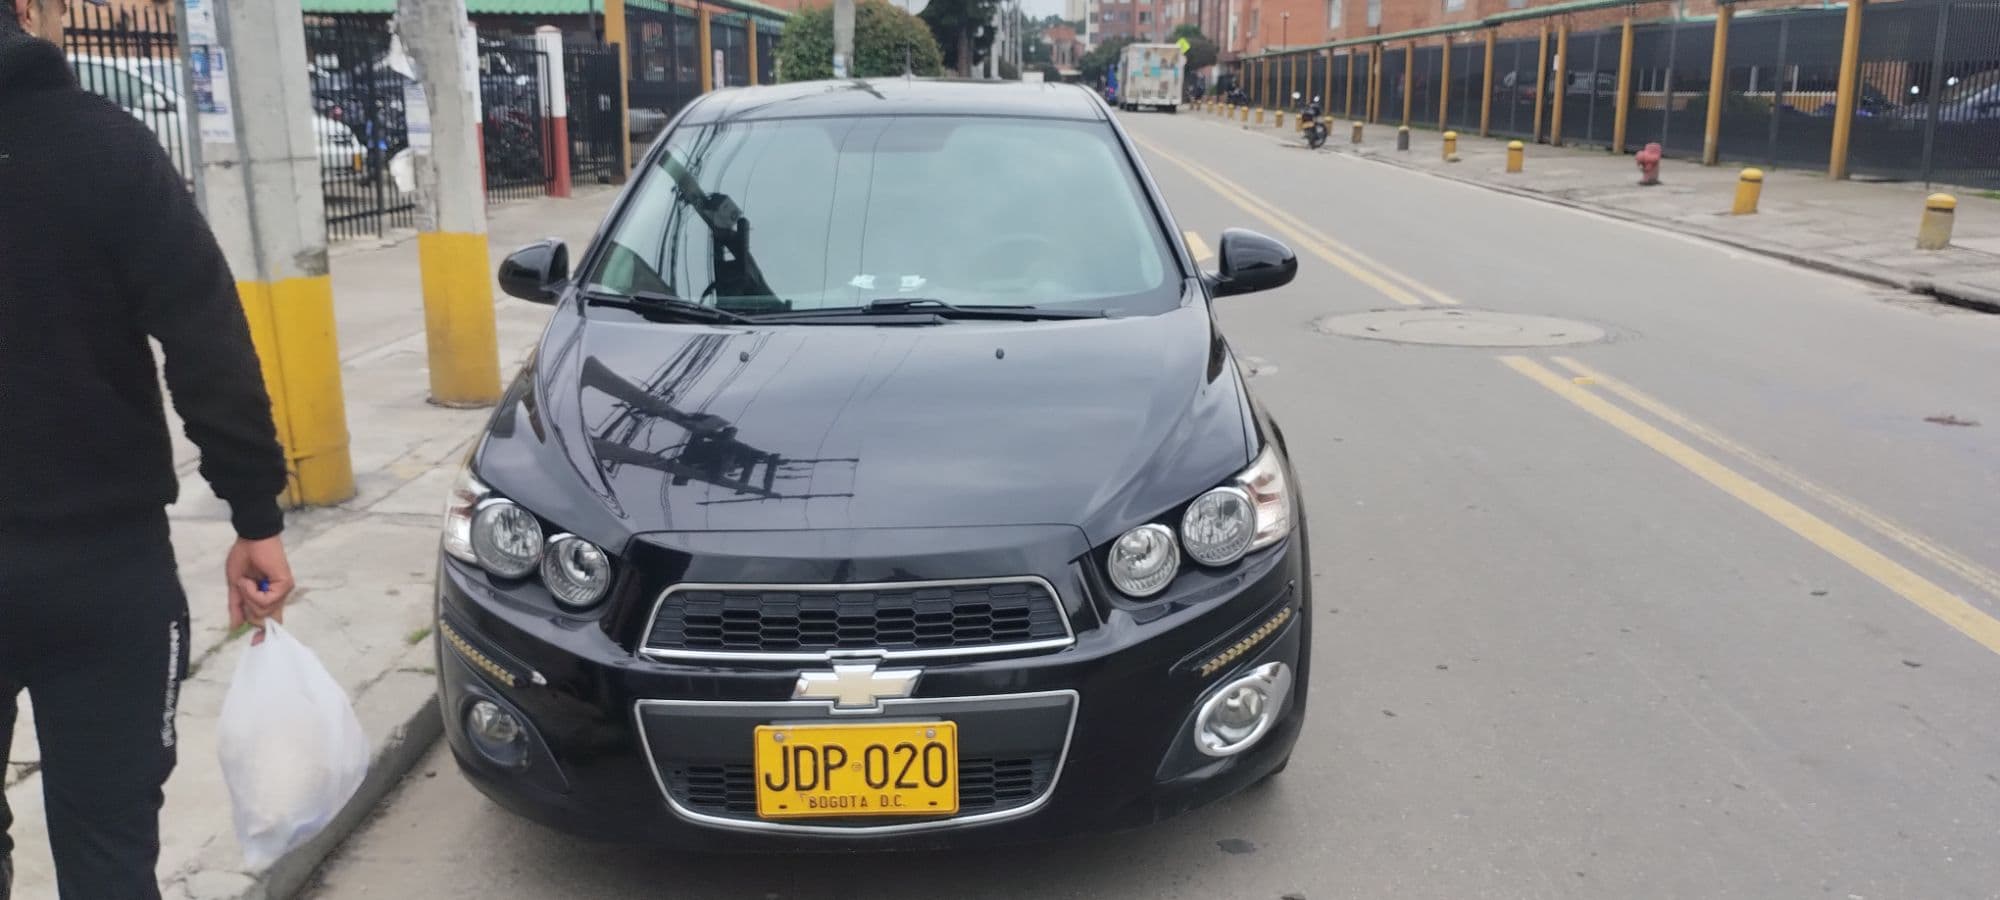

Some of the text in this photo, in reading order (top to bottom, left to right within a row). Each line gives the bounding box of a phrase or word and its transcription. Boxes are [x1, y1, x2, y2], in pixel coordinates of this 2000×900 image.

[765, 742, 948, 792] JDP 020
[809, 794, 906, 809] BOGOTA D.C.
